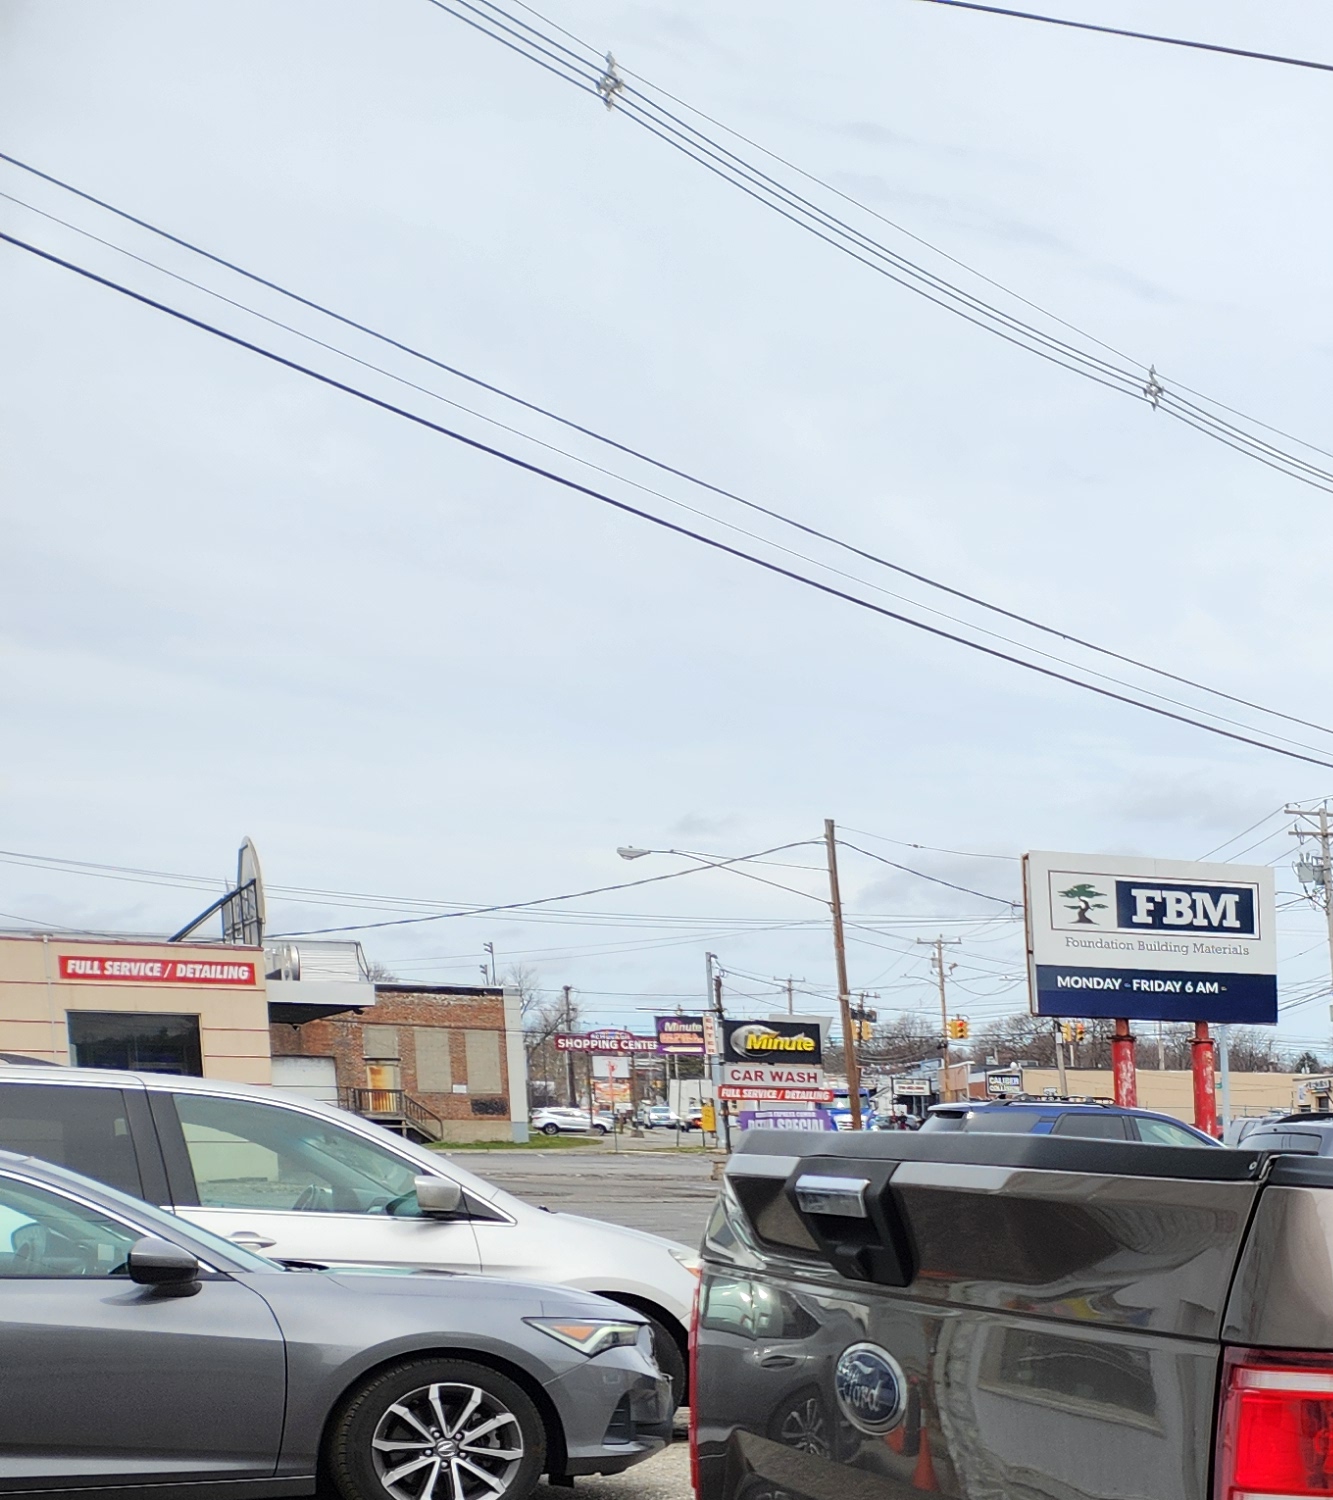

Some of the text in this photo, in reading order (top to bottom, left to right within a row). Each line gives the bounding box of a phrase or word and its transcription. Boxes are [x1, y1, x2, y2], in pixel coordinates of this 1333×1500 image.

[1131, 888, 1241, 928] FBM
[1065, 936, 1250, 956] Foundation Building Materials
[66, 959, 101, 974] FULL
[103, 961, 161, 977] SERVICE
[176, 964, 249, 980] DETAILING
[1057, 975, 1122, 990] MONDAY
[1132, 979, 1182, 993] FRIDAY
[1185, 980, 1194, 993] 6
[1196, 981, 1219, 994] AM
[664, 1021, 703, 1032] Minute
[558, 1038, 619, 1050] SHOPPING
[745, 1033, 816, 1051] Minute
[731, 1069, 818, 1083] CAR WASH
[721, 1088, 741, 1098] FULL
[742, 1089, 778, 1099] SERVICE
[784, 1089, 831, 1101] DETAILING
[838, 1360, 882, 1412] Ford
